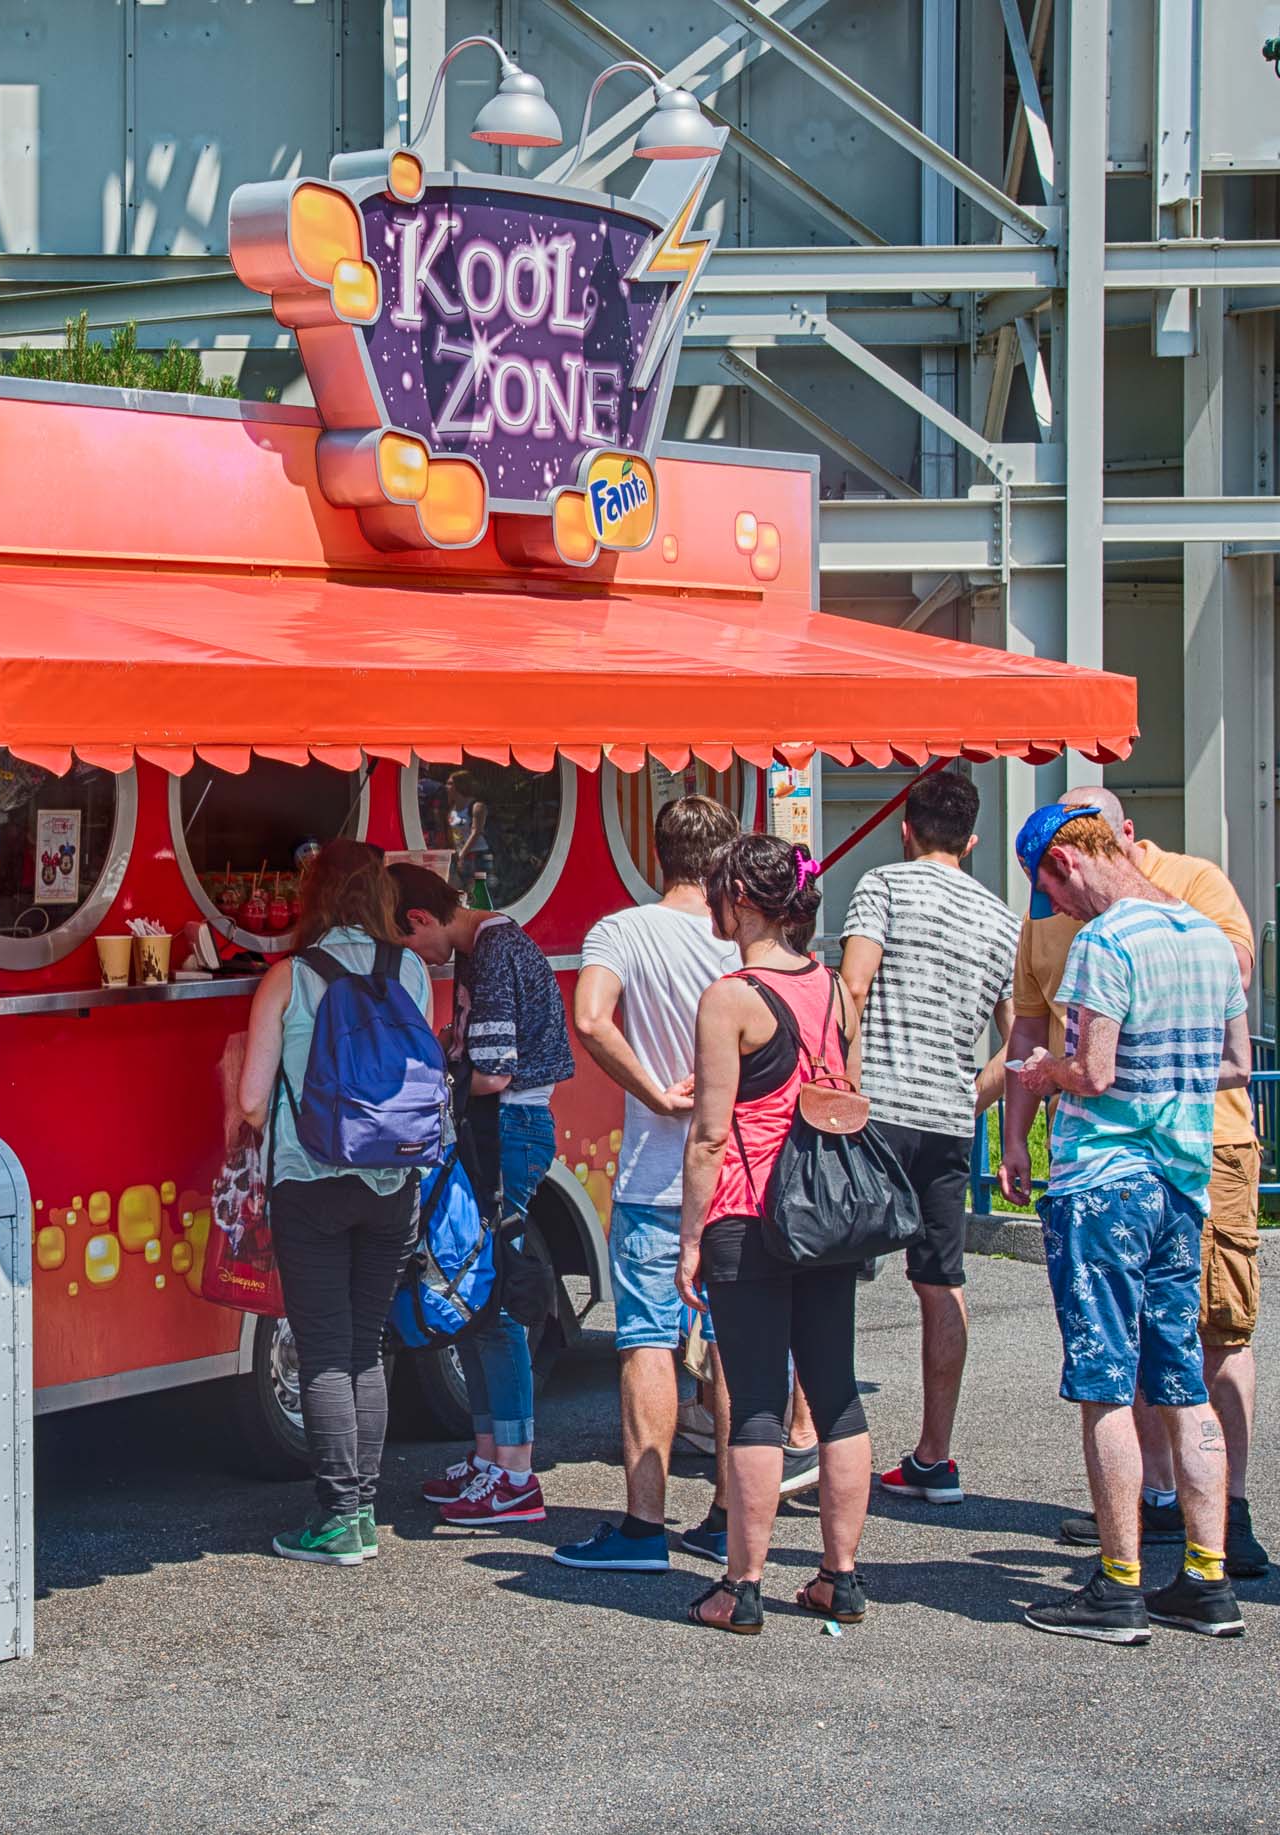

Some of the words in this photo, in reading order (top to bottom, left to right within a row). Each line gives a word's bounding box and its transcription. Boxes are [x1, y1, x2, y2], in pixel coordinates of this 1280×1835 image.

[395, 217, 592, 330] KOOL
[436, 330, 619, 443] ZONE
[590, 473, 648, 537] Fanta
